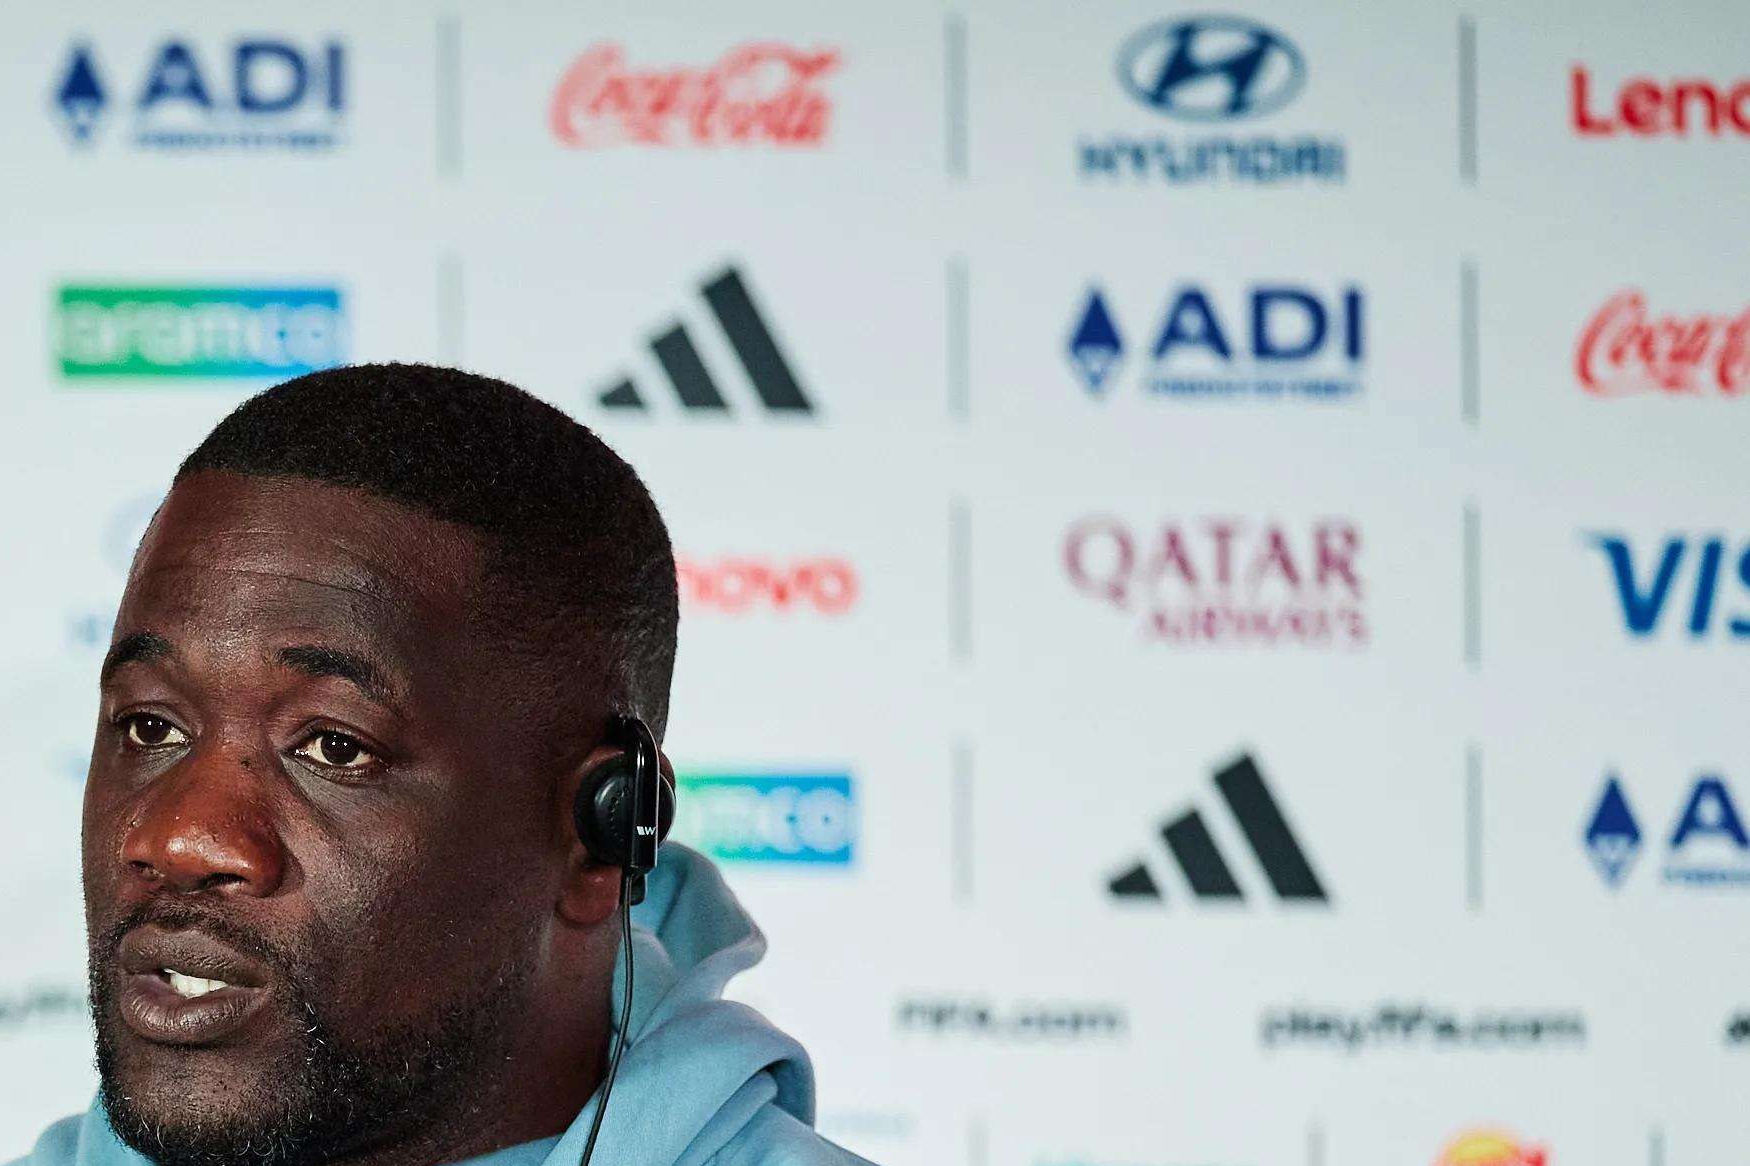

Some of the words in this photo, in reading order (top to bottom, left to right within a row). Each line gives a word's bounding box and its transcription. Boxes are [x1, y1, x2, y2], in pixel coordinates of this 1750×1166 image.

[137, 39, 346, 114] ADI
[1152, 285, 1364, 363] ADI
[1063, 518, 1362, 605] QATAR
